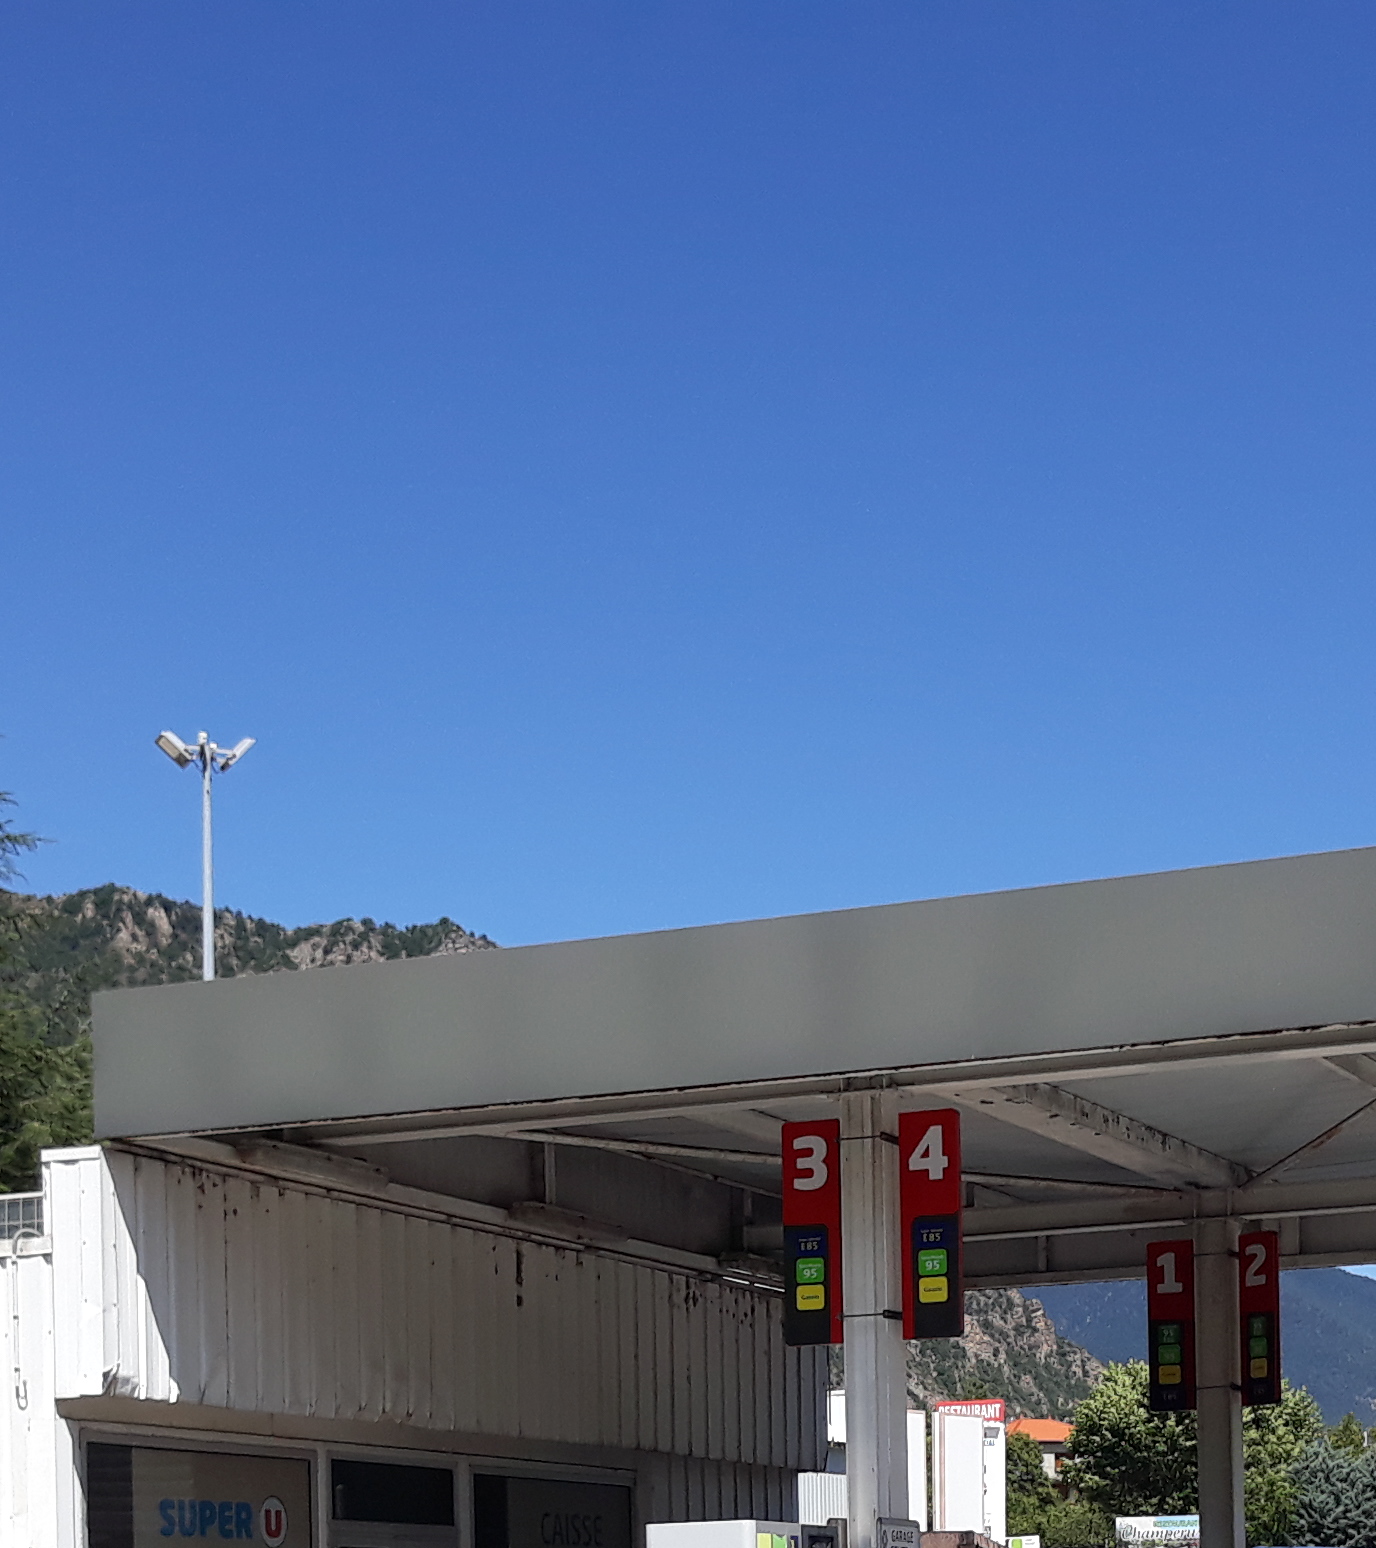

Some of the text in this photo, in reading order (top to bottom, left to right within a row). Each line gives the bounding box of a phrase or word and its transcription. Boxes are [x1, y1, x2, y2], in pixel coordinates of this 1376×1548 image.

[792, 1135, 828, 1191] 3
[908, 1124, 949, 1181] 4
[803, 1269, 818, 1279] 95
[926, 1260, 941, 1271] 95
[1155, 1253, 1183, 1294] 1
[1244, 1244, 1267, 1288] 2
[158, 1498, 254, 1539] SUPER
[541, 1512, 604, 1546] CAISSE
